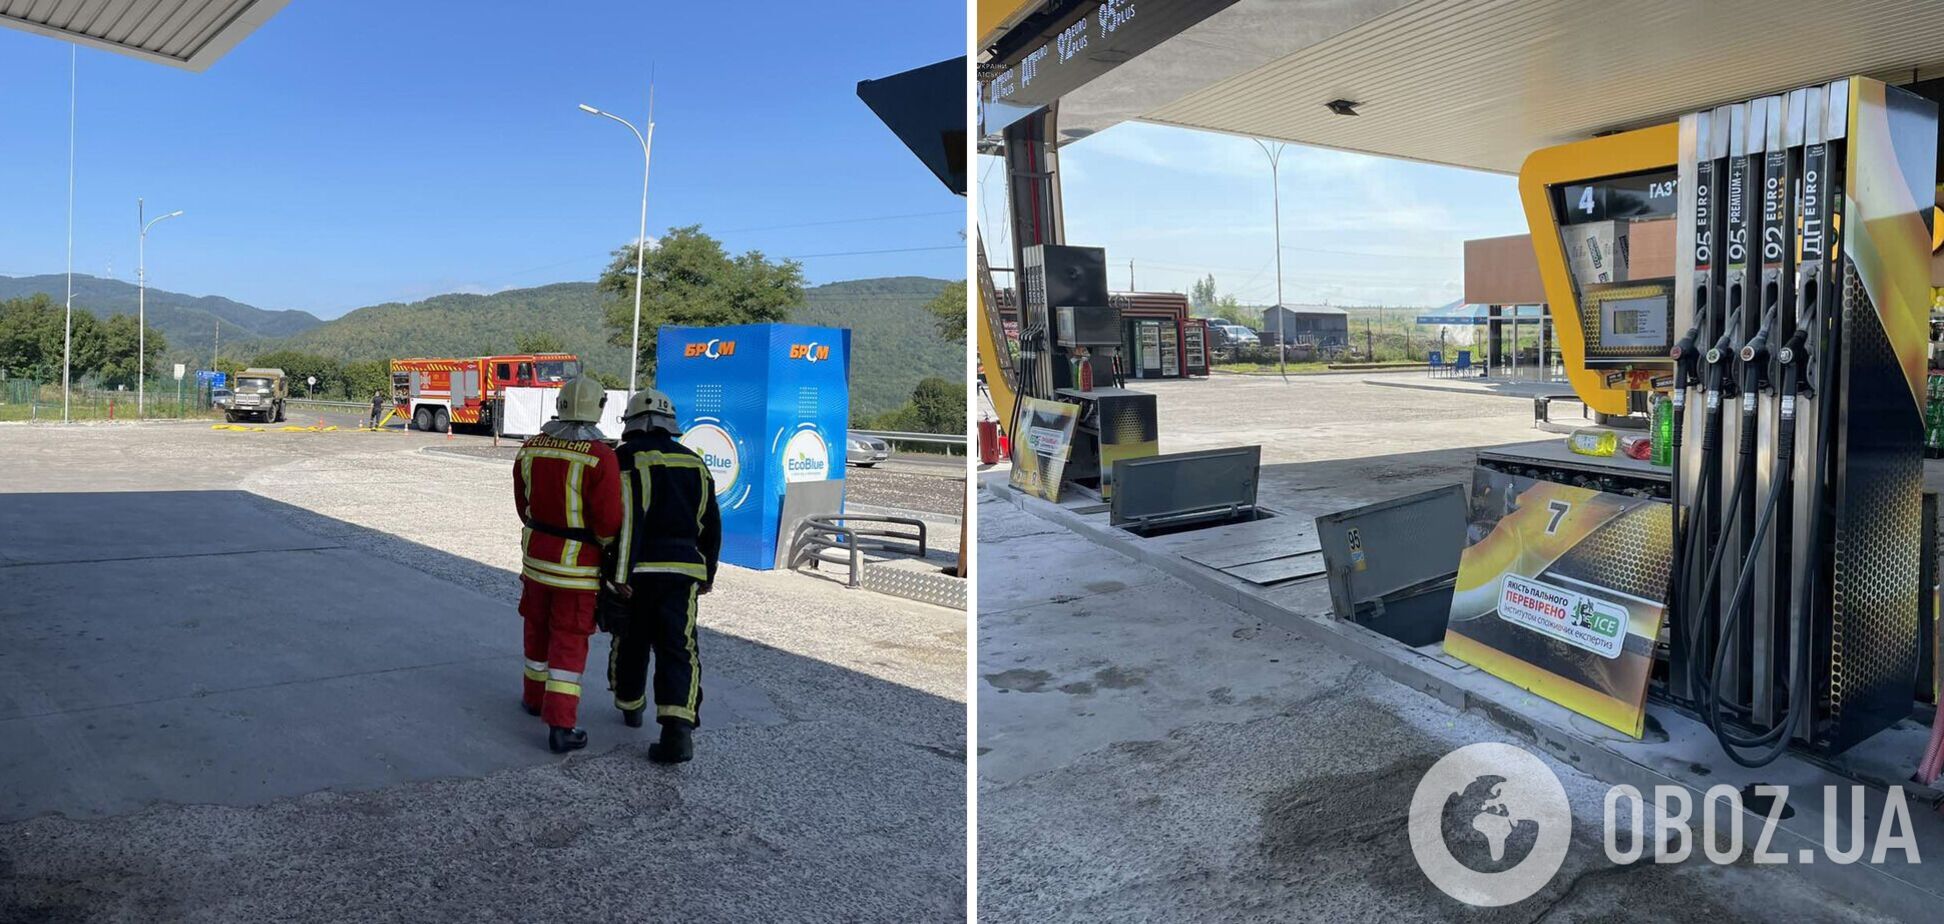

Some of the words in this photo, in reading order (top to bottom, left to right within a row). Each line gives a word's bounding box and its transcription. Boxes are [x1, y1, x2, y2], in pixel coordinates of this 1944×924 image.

[1117, 4, 1135, 26] PLUS
[1057, 33, 1073, 64] 92
[1072, 35, 1088, 54] PLUS
[1578, 186, 1595, 214] 4
[1697, 185, 1708, 226] EURO
[1730, 171, 1742, 223] PREMIUM+
[1766, 177, 1778, 221] EURO
[1777, 176, 1785, 220] PLUS
[1805, 170, 1818, 216] EURO
[1696, 230, 1712, 261] 95
[1764, 225, 1784, 259] 92
[1803, 219, 1822, 255] ДП
[684, 338, 736, 360] БРСМ
[789, 342, 830, 363] БРСМ
[527, 435, 592, 453] FEUERWEHR
[788, 457, 824, 471] EcoBlue
[1546, 500, 1571, 536] 7
[1348, 529, 1361, 550] 95
[1505, 590, 1566, 620] ПЕРЕВІРЕНО
[1507, 580, 1530, 595] ЯКІСТЬ
[1529, 588, 1568, 607] ПАЛЬНОГО
[1574, 629, 1613, 650] експертиз
[1593, 617, 1617, 633] ICE
